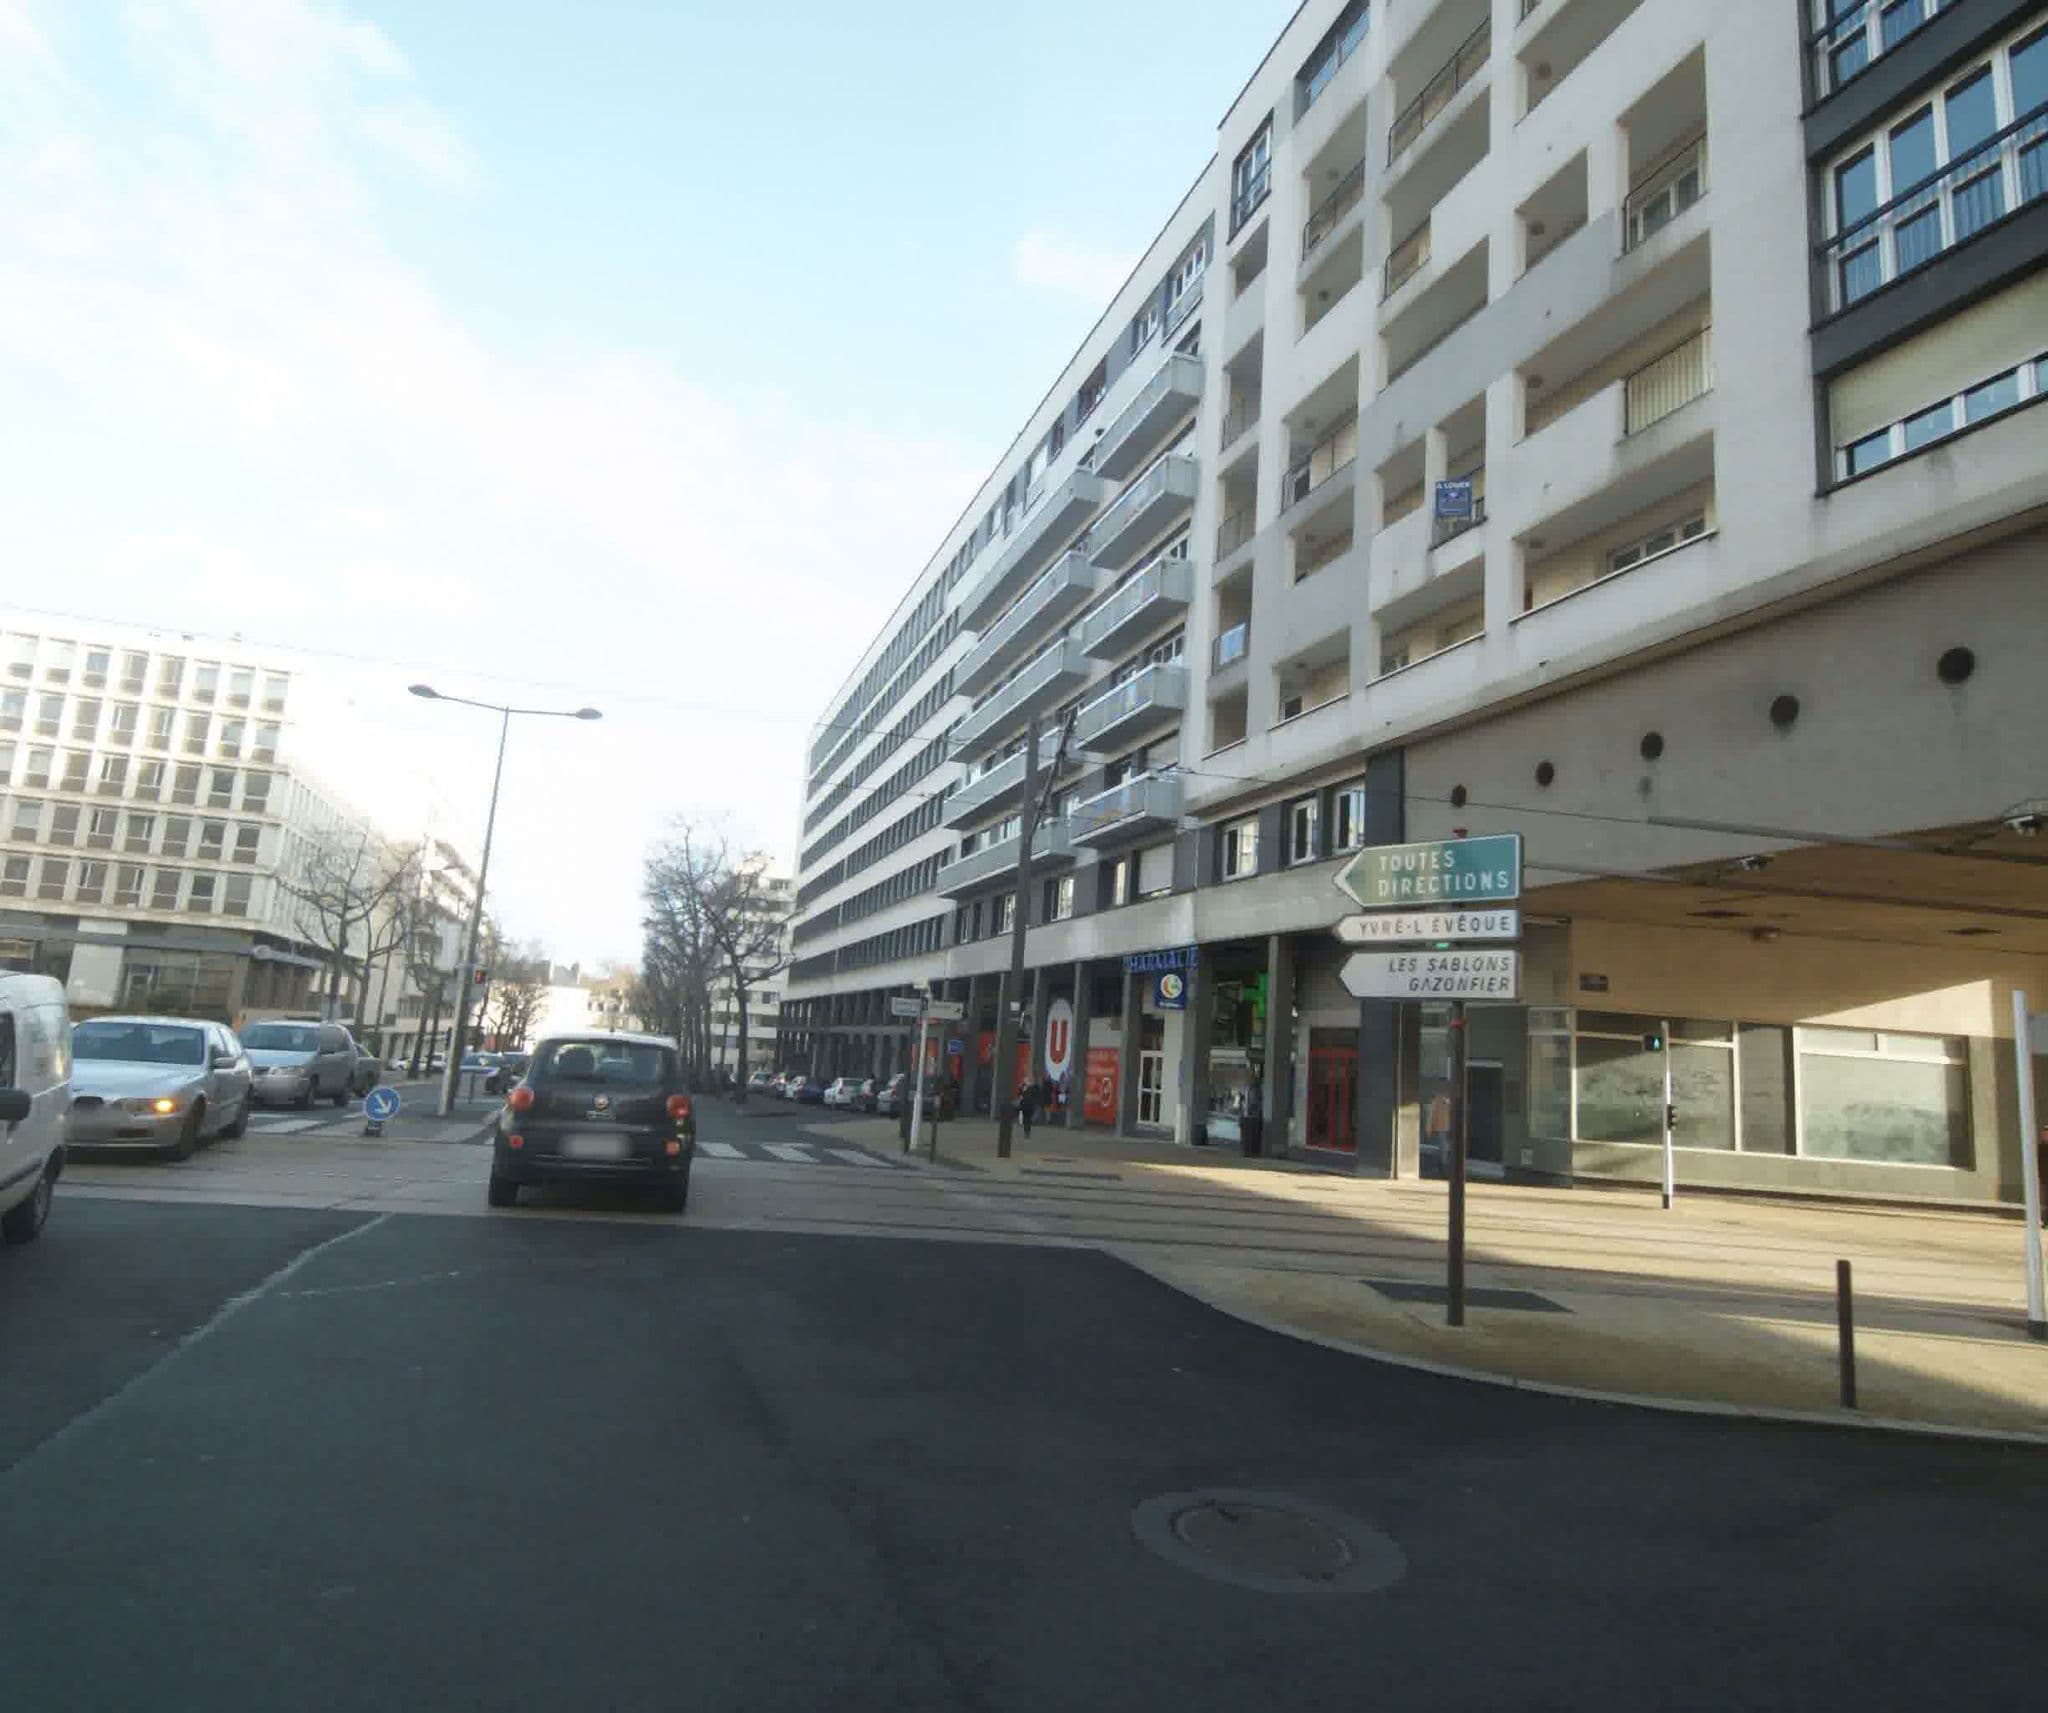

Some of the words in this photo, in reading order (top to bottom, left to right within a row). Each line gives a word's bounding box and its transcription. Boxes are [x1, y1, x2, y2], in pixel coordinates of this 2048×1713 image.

[1379, 850, 1455, 871] TOUTES
[1378, 871, 1508, 897] DIRECTIONS
[1389, 958, 1417, 973] LES
[1427, 956, 1510, 973] SABLONS
[1408, 977, 1510, 992] GAZONFIER
[1050, 1020, 1067, 1064] U
